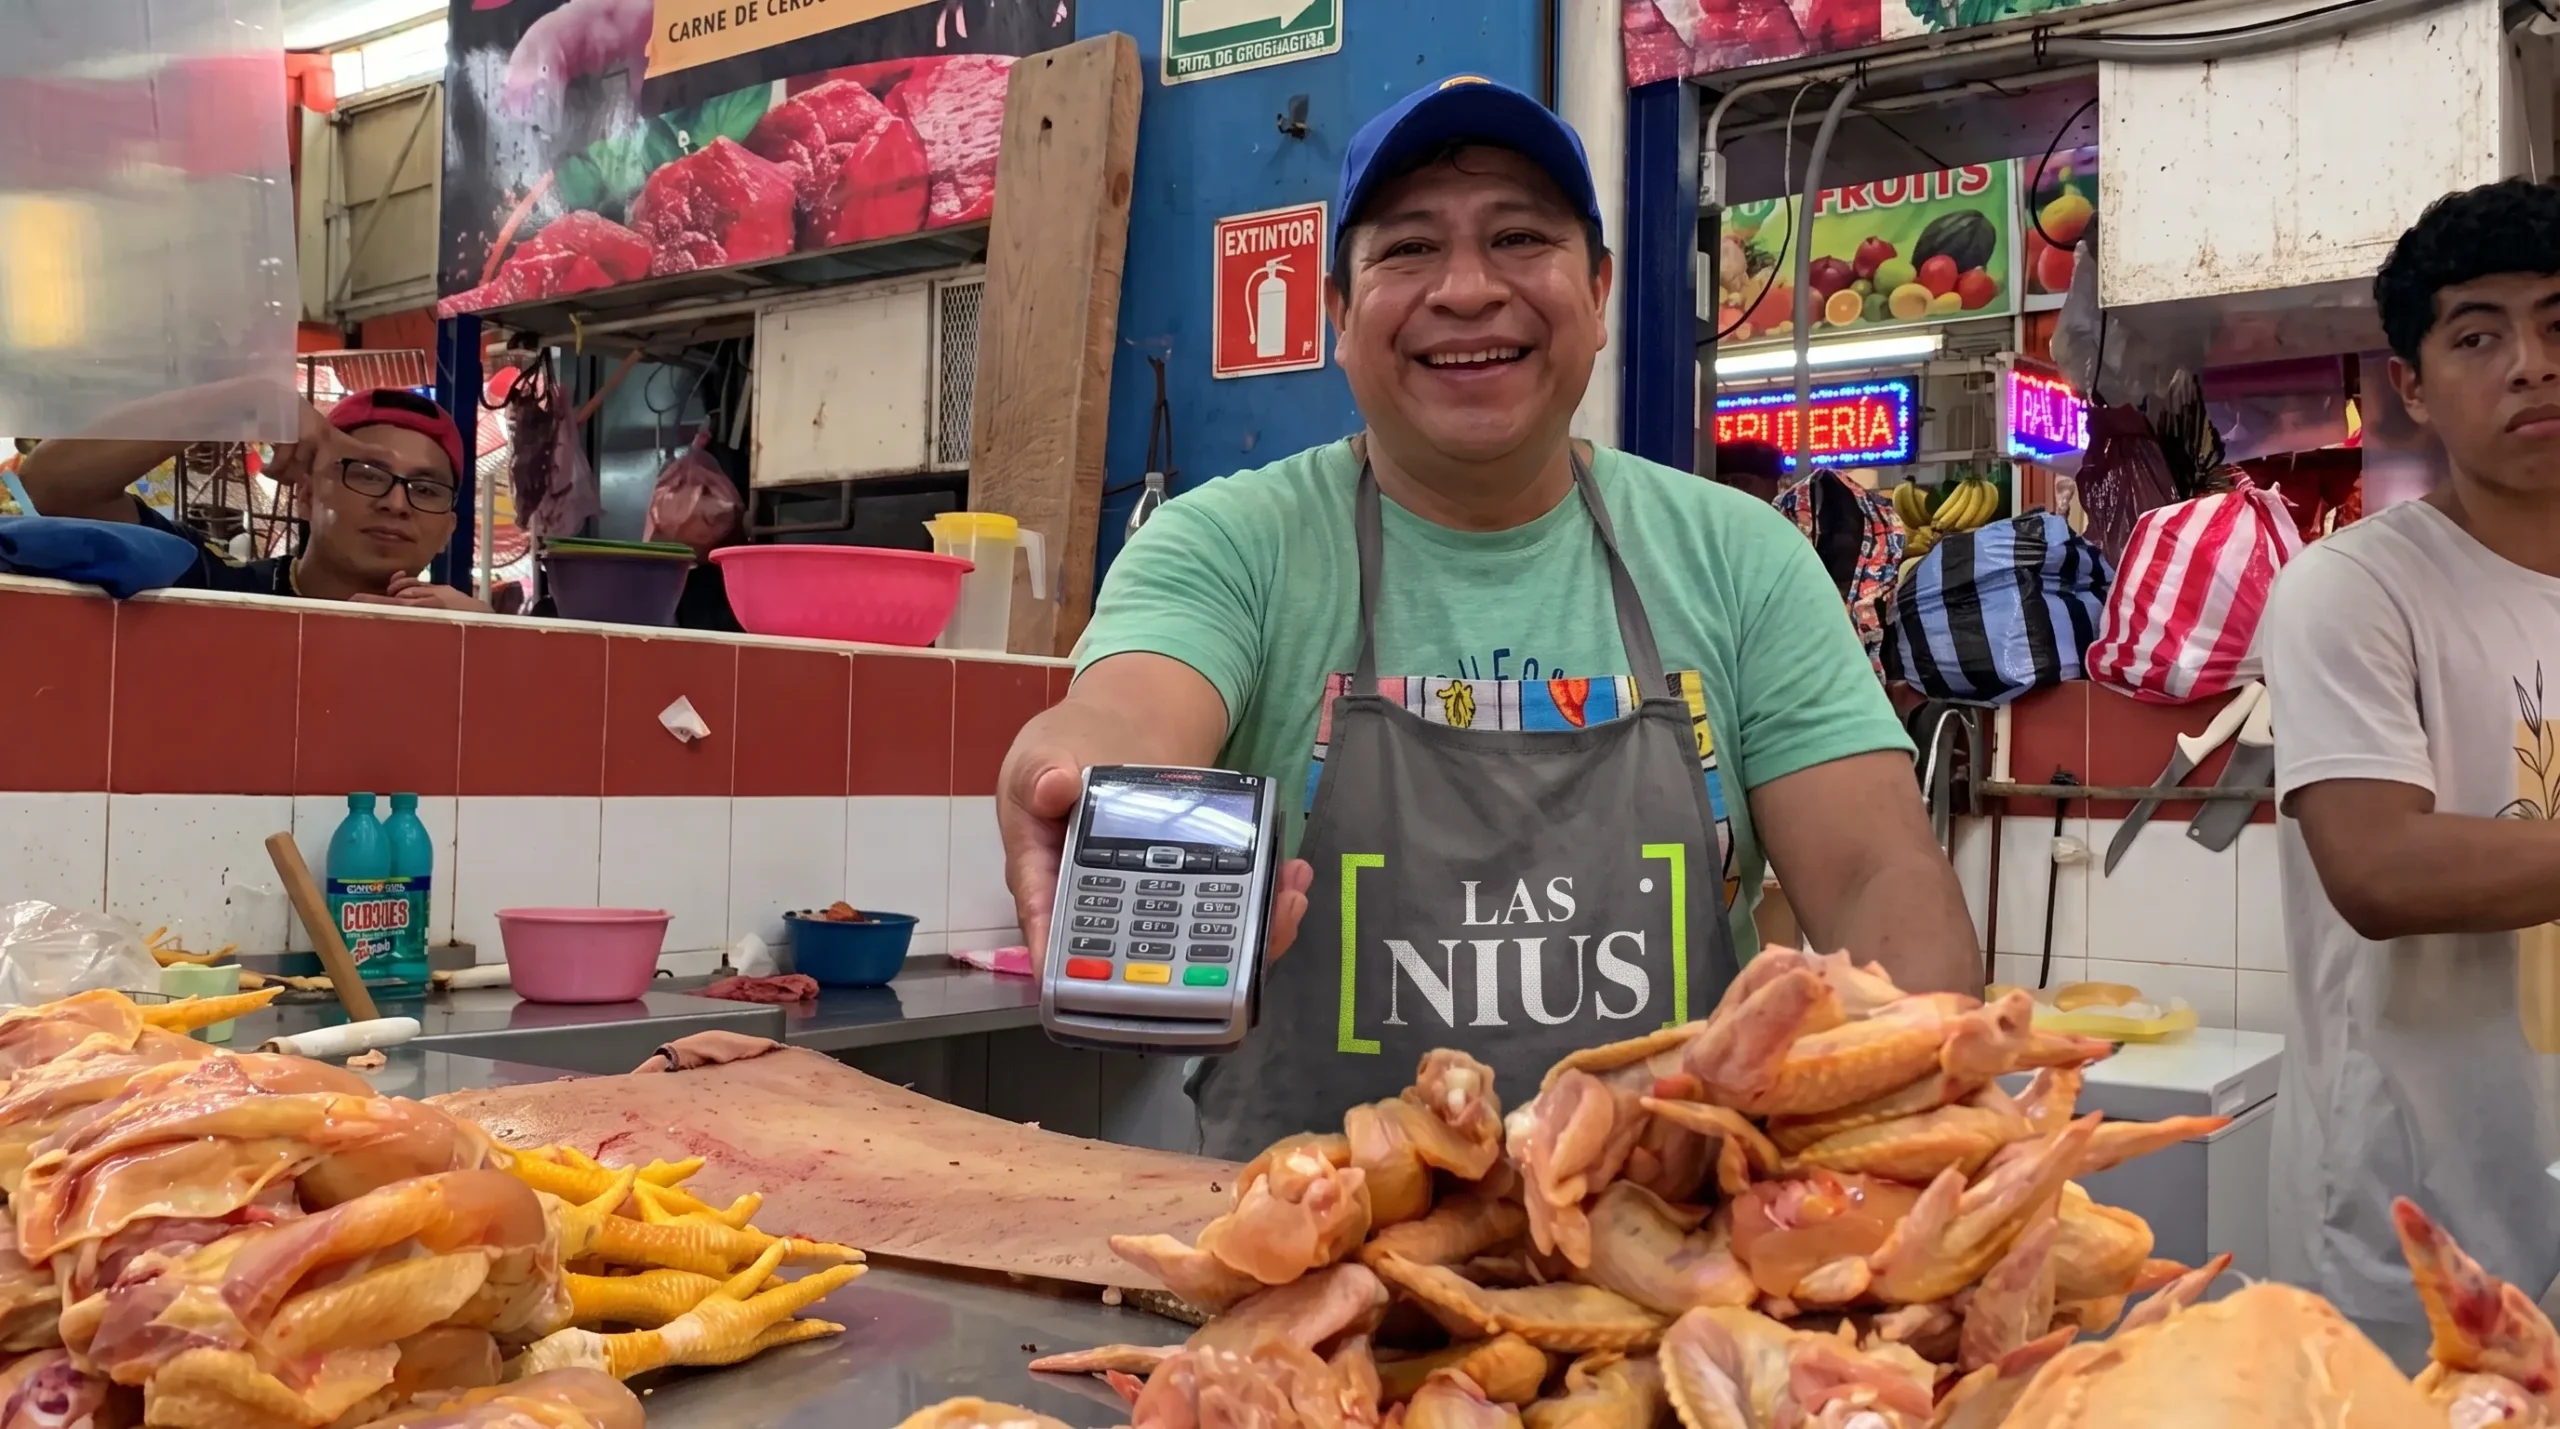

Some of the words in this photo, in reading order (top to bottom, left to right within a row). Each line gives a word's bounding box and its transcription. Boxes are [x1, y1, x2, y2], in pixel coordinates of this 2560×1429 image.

[668, 9, 727, 43] CARNE
[735, 1, 758, 27] DE
[767, 0, 826, 16] CER
[1225, 219, 1315, 256] EXTINTOR
[1461, 876, 1576, 925] LAS
[1382, 930, 1650, 1028] NIUS
